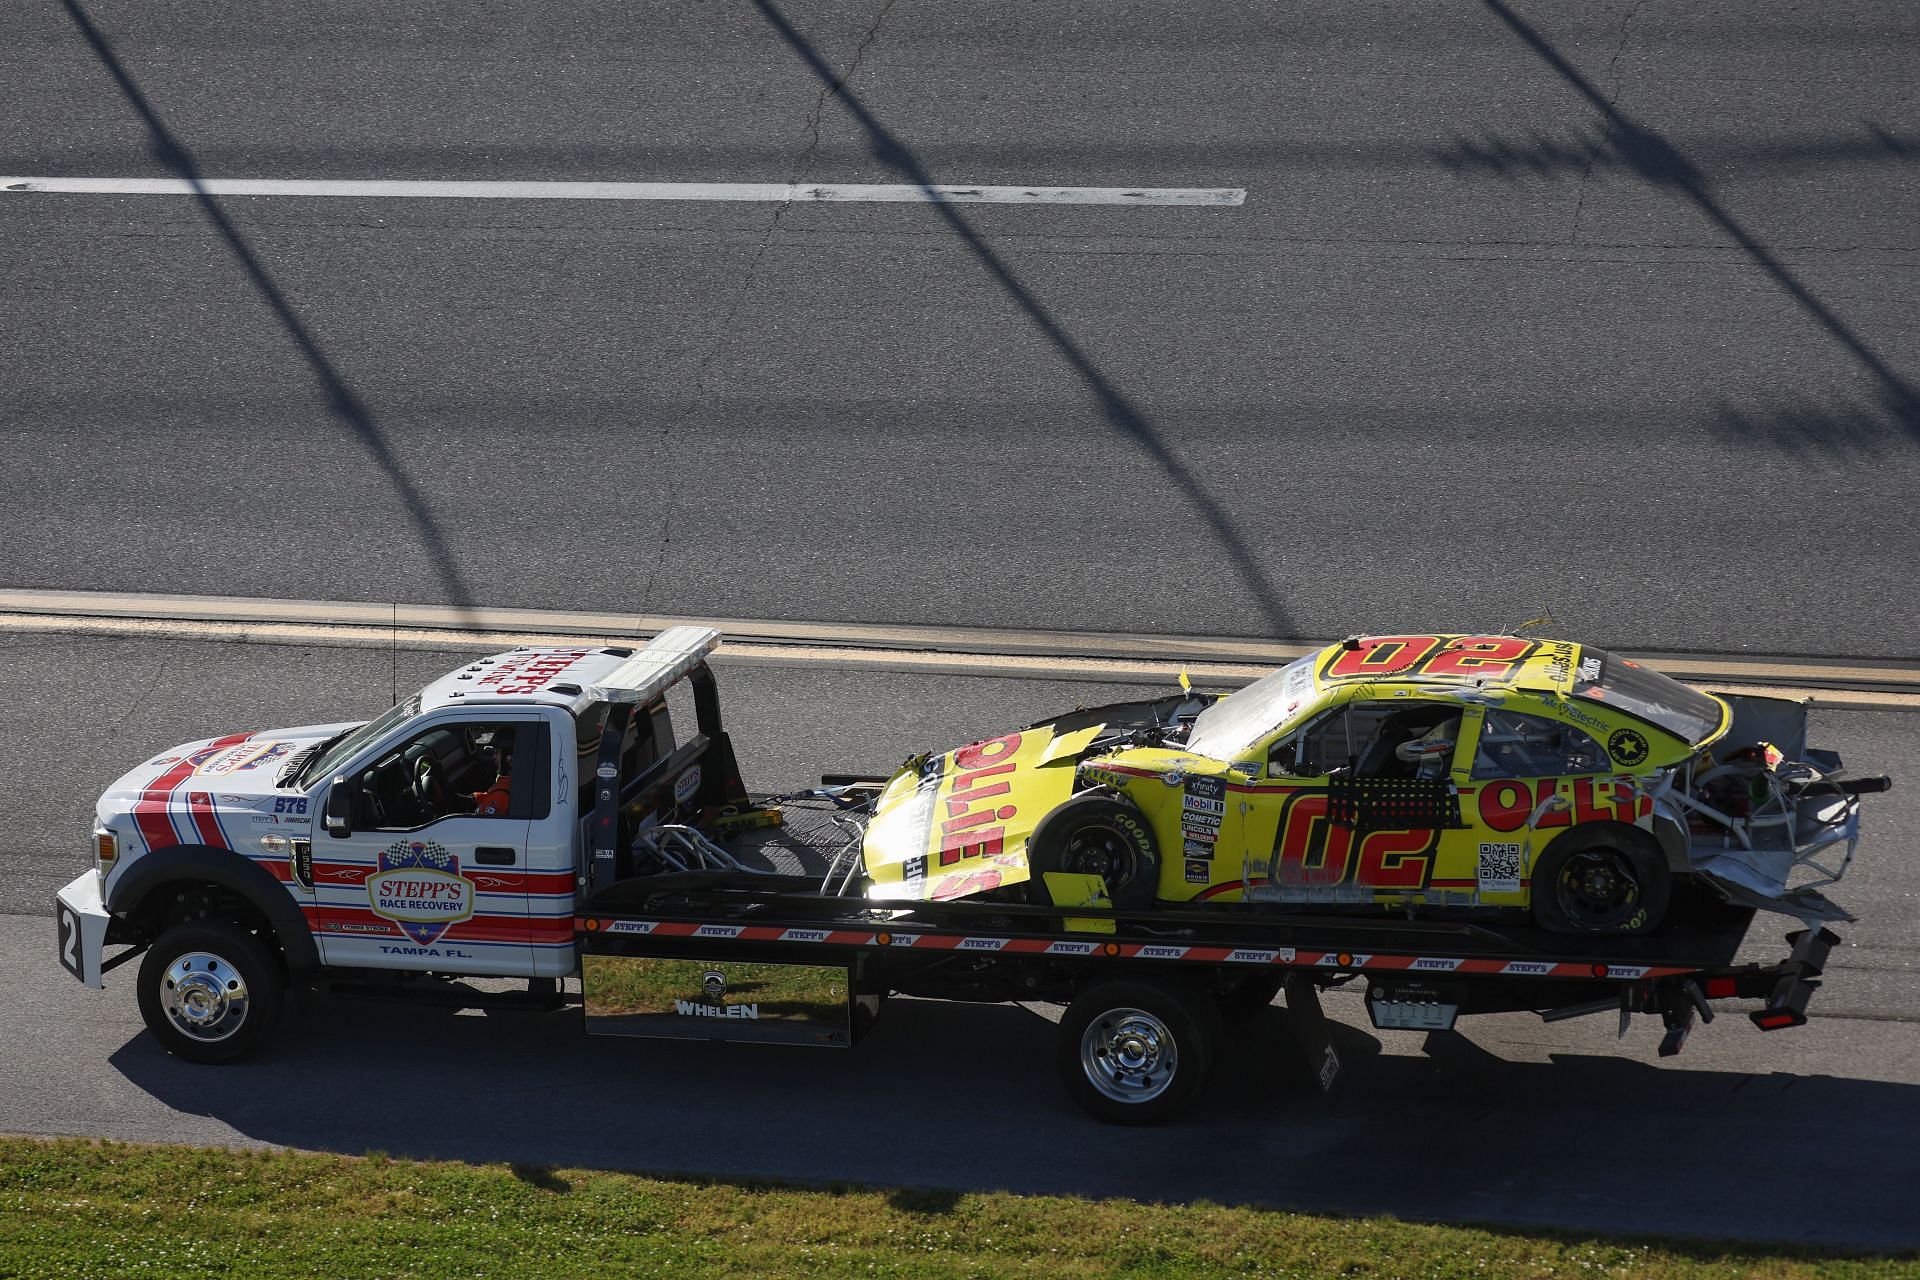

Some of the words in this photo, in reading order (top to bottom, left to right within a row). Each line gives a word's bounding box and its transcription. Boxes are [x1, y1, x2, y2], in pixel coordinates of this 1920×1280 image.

[1328, 636, 1534, 678] 02
[1191, 781, 1219, 795] xfinity
[274, 798, 308, 814] 576
[1185, 796, 1212, 810] Mobil
[286, 816, 312, 825] NASCAR
[1183, 824, 1212, 834] LINCOLN
[1277, 793, 1437, 888] 02
[379, 880, 461, 900] STEPP'S
[380, 899, 407, 909] RACE
[408, 900, 463, 911] RECOVERY
[614, 922, 650, 932] STEPP'S
[701, 926, 736, 936] STEPP'S
[62, 910, 77, 970] 2
[788, 930, 824, 940] STEPP'S
[964, 939, 1000, 949] STEPP'S
[1053, 943, 1089, 953] STEPP'S
[379, 946, 440, 957] TAMPA
[446, 949, 472, 958] FL.
[1144, 948, 1181, 957] STEPP'S
[1234, 951, 1272, 961] STEPP'S
[1417, 959, 1455, 968] STEPP'S
[1509, 963, 1547, 973] STEPP'S
[1608, 967, 1641, 976] TEPP'S
